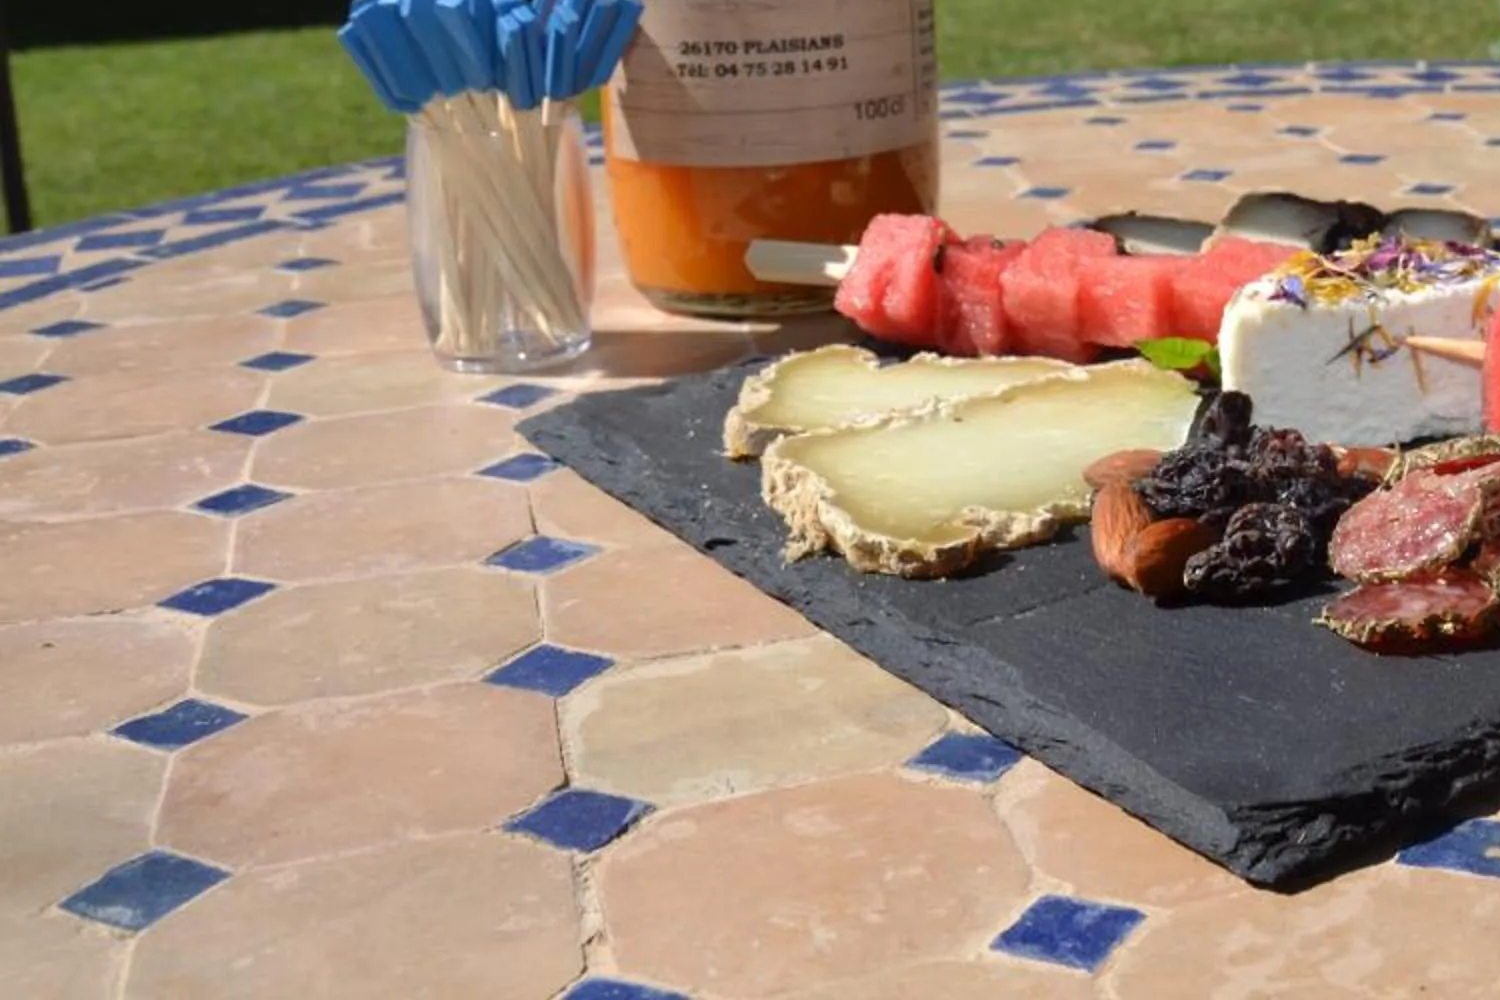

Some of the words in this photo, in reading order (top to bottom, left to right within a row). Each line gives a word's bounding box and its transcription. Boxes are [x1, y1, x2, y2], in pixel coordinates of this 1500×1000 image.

[680, 40, 738, 56] 26170
[743, 35, 845, 55] PLAISIANS
[714, 62, 739, 77] 04
[745, 62, 767, 76] 75
[773, 60, 796, 76] 28
[802, 59, 822, 73] 14
[826, 56, 848, 71] 91
